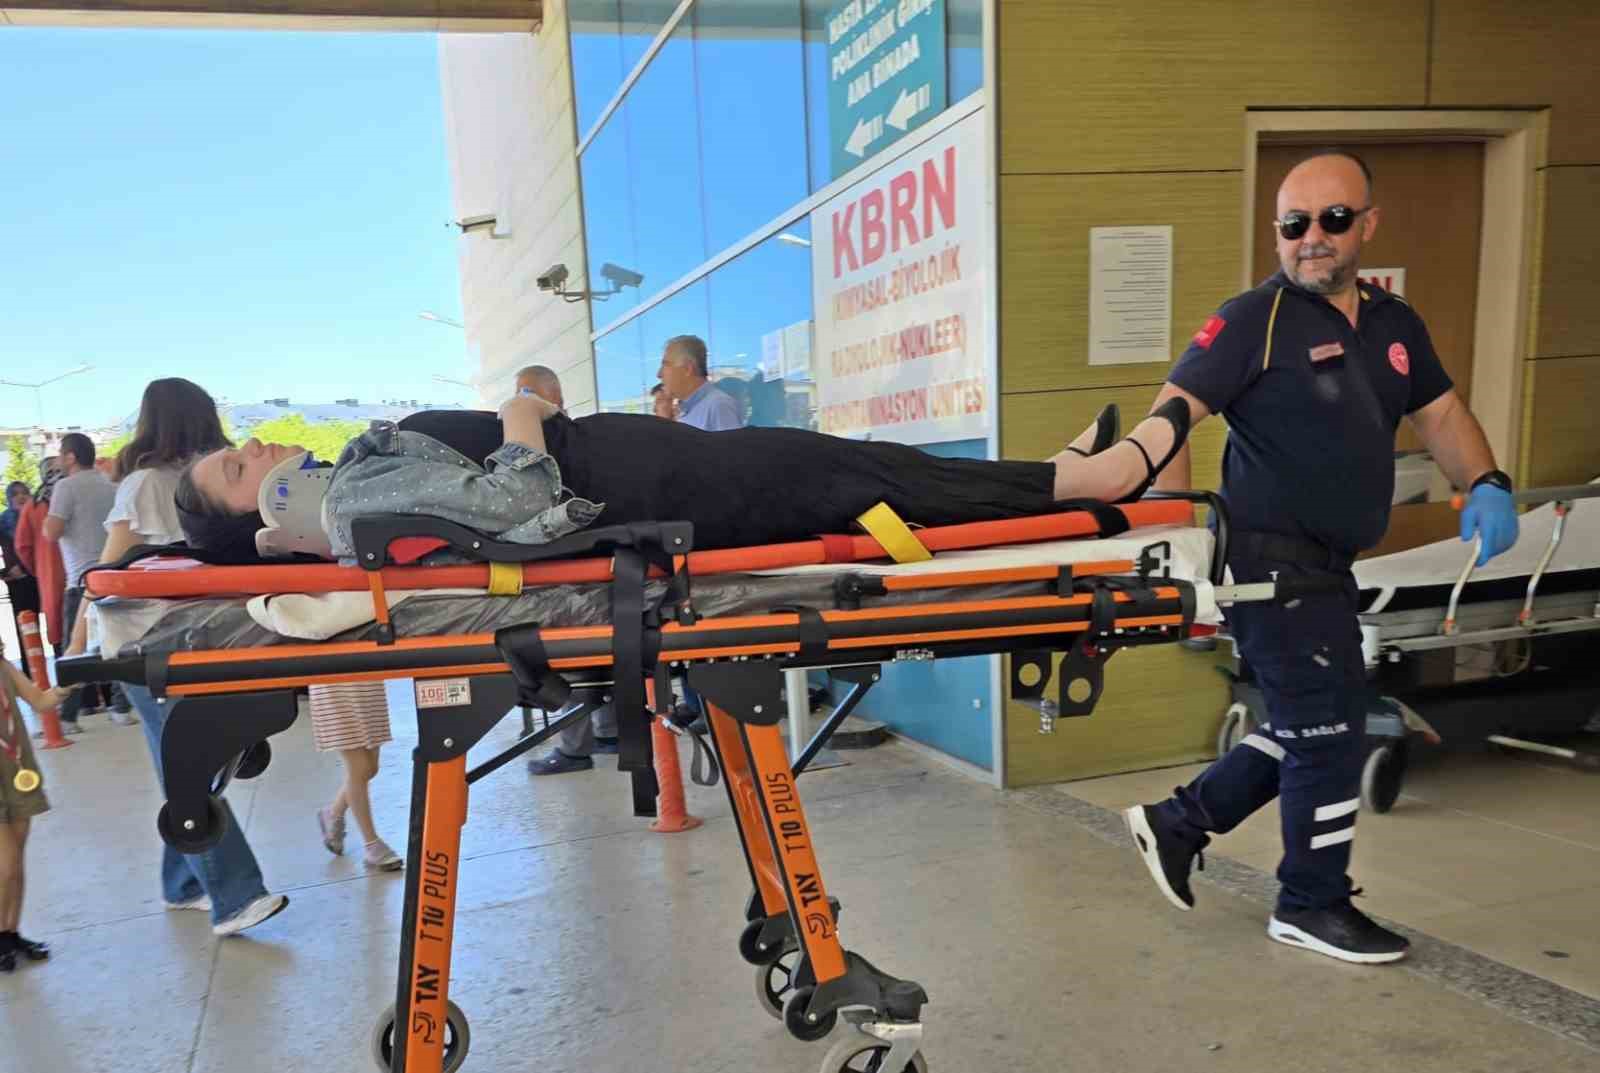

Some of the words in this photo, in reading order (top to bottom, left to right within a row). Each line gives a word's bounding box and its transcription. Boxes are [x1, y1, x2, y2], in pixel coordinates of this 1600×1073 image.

[832, 145, 956, 279] KBRN
[766, 772, 796, 814] PLUS
[424, 850, 449, 899] PLUS
[794, 873, 821, 908] TAY
[416, 964, 440, 1005] TAY
